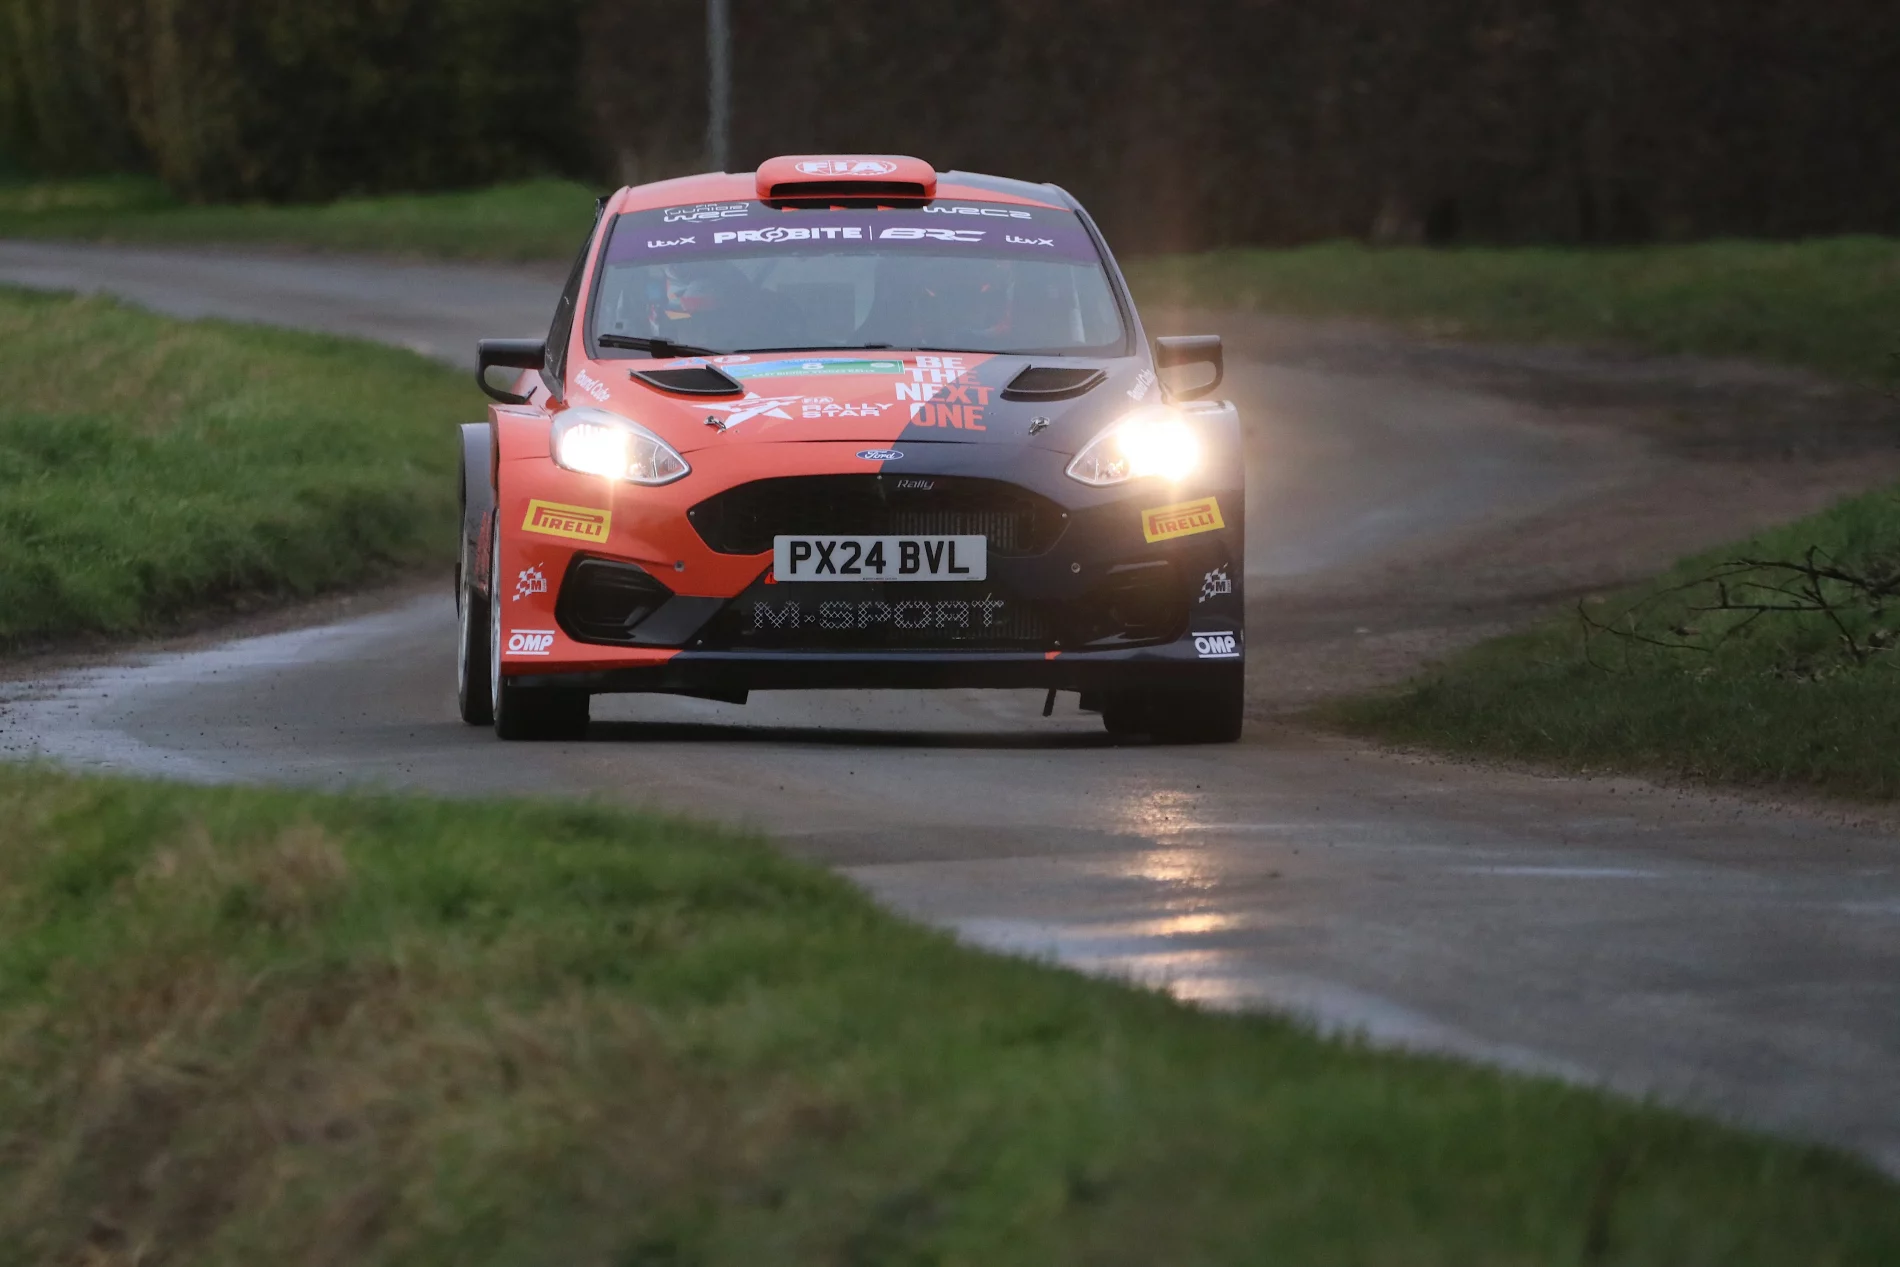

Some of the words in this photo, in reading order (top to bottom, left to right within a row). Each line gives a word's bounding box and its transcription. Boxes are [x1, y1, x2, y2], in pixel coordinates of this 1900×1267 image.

[802, 160, 888, 173] FIA
[663, 209, 748, 222] WRC
[922, 205, 1032, 219] WRC2
[879, 227, 987, 242] BRC
[914, 355, 966, 370] BE
[904, 367, 982, 385] THE
[895, 382, 994, 407] NEXT
[802, 403, 894, 411] RALLY
[802, 409, 880, 418] STAR
[909, 402, 987, 431] ONE
[864, 450, 895, 460] Ford
[897, 479, 935, 491] Rally
[532, 507, 605, 536] PIRELLI
[1148, 503, 1216, 536] PIRELLI
[790, 541, 887, 575] PX24
[898, 541, 970, 574] BVL
[508, 634, 554, 652] OMP
[1195, 637, 1235, 654] OMP
